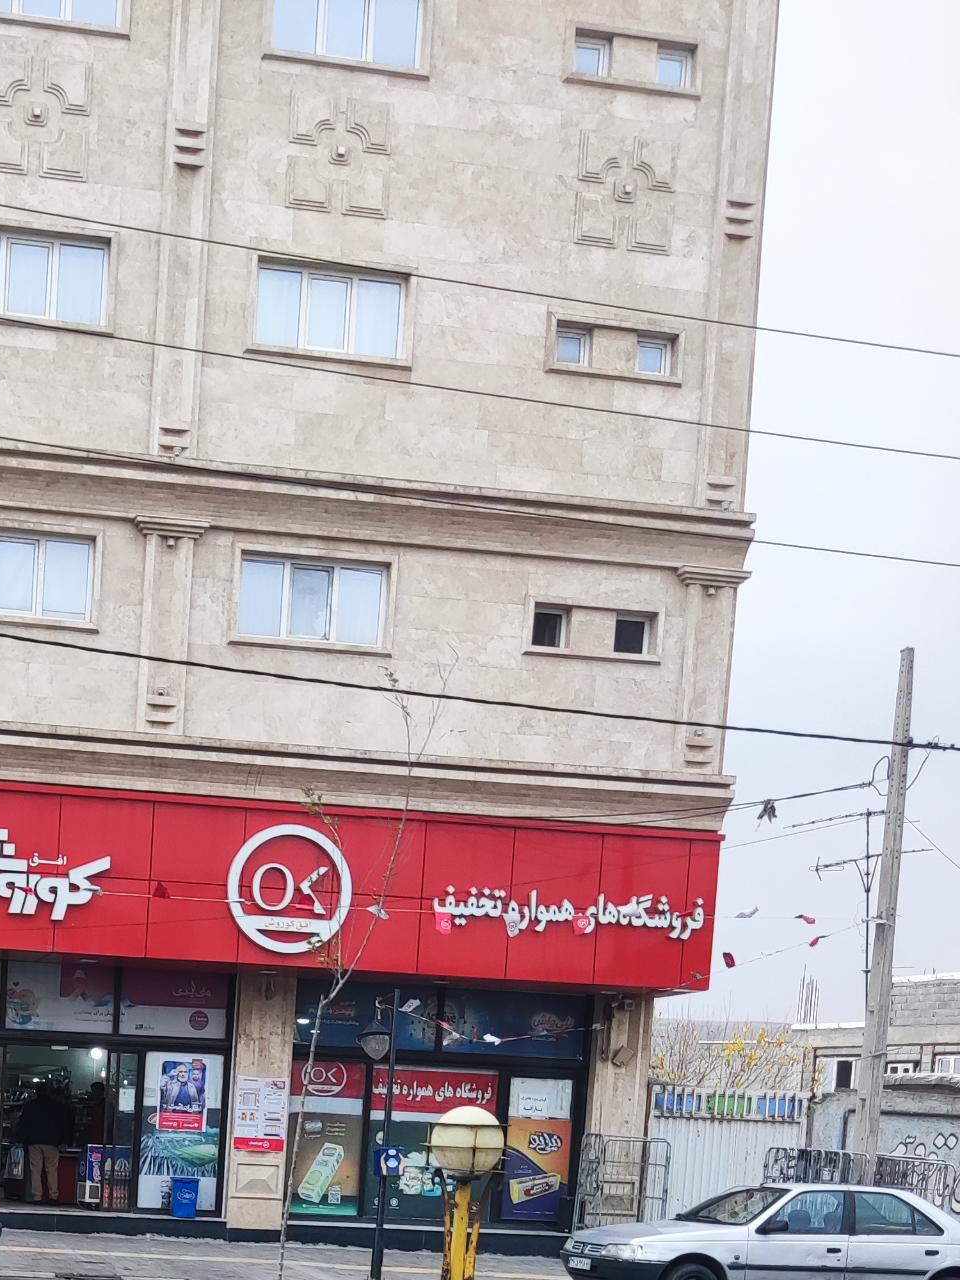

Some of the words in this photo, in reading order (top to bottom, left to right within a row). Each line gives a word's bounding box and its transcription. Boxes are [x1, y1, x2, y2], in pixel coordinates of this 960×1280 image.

[29, 853, 67, 866] افق
[433, 885, 505, 927] تخفیف
[506, 889, 575, 933] همواره
[264, 918, 295, 930] کوروش
[310, 1067, 338, 1083] OK
[402, 1080, 434, 1101] همواره
[435, 1081, 454, 1102] های
[456, 1082, 493, 1105] فروشگاه
